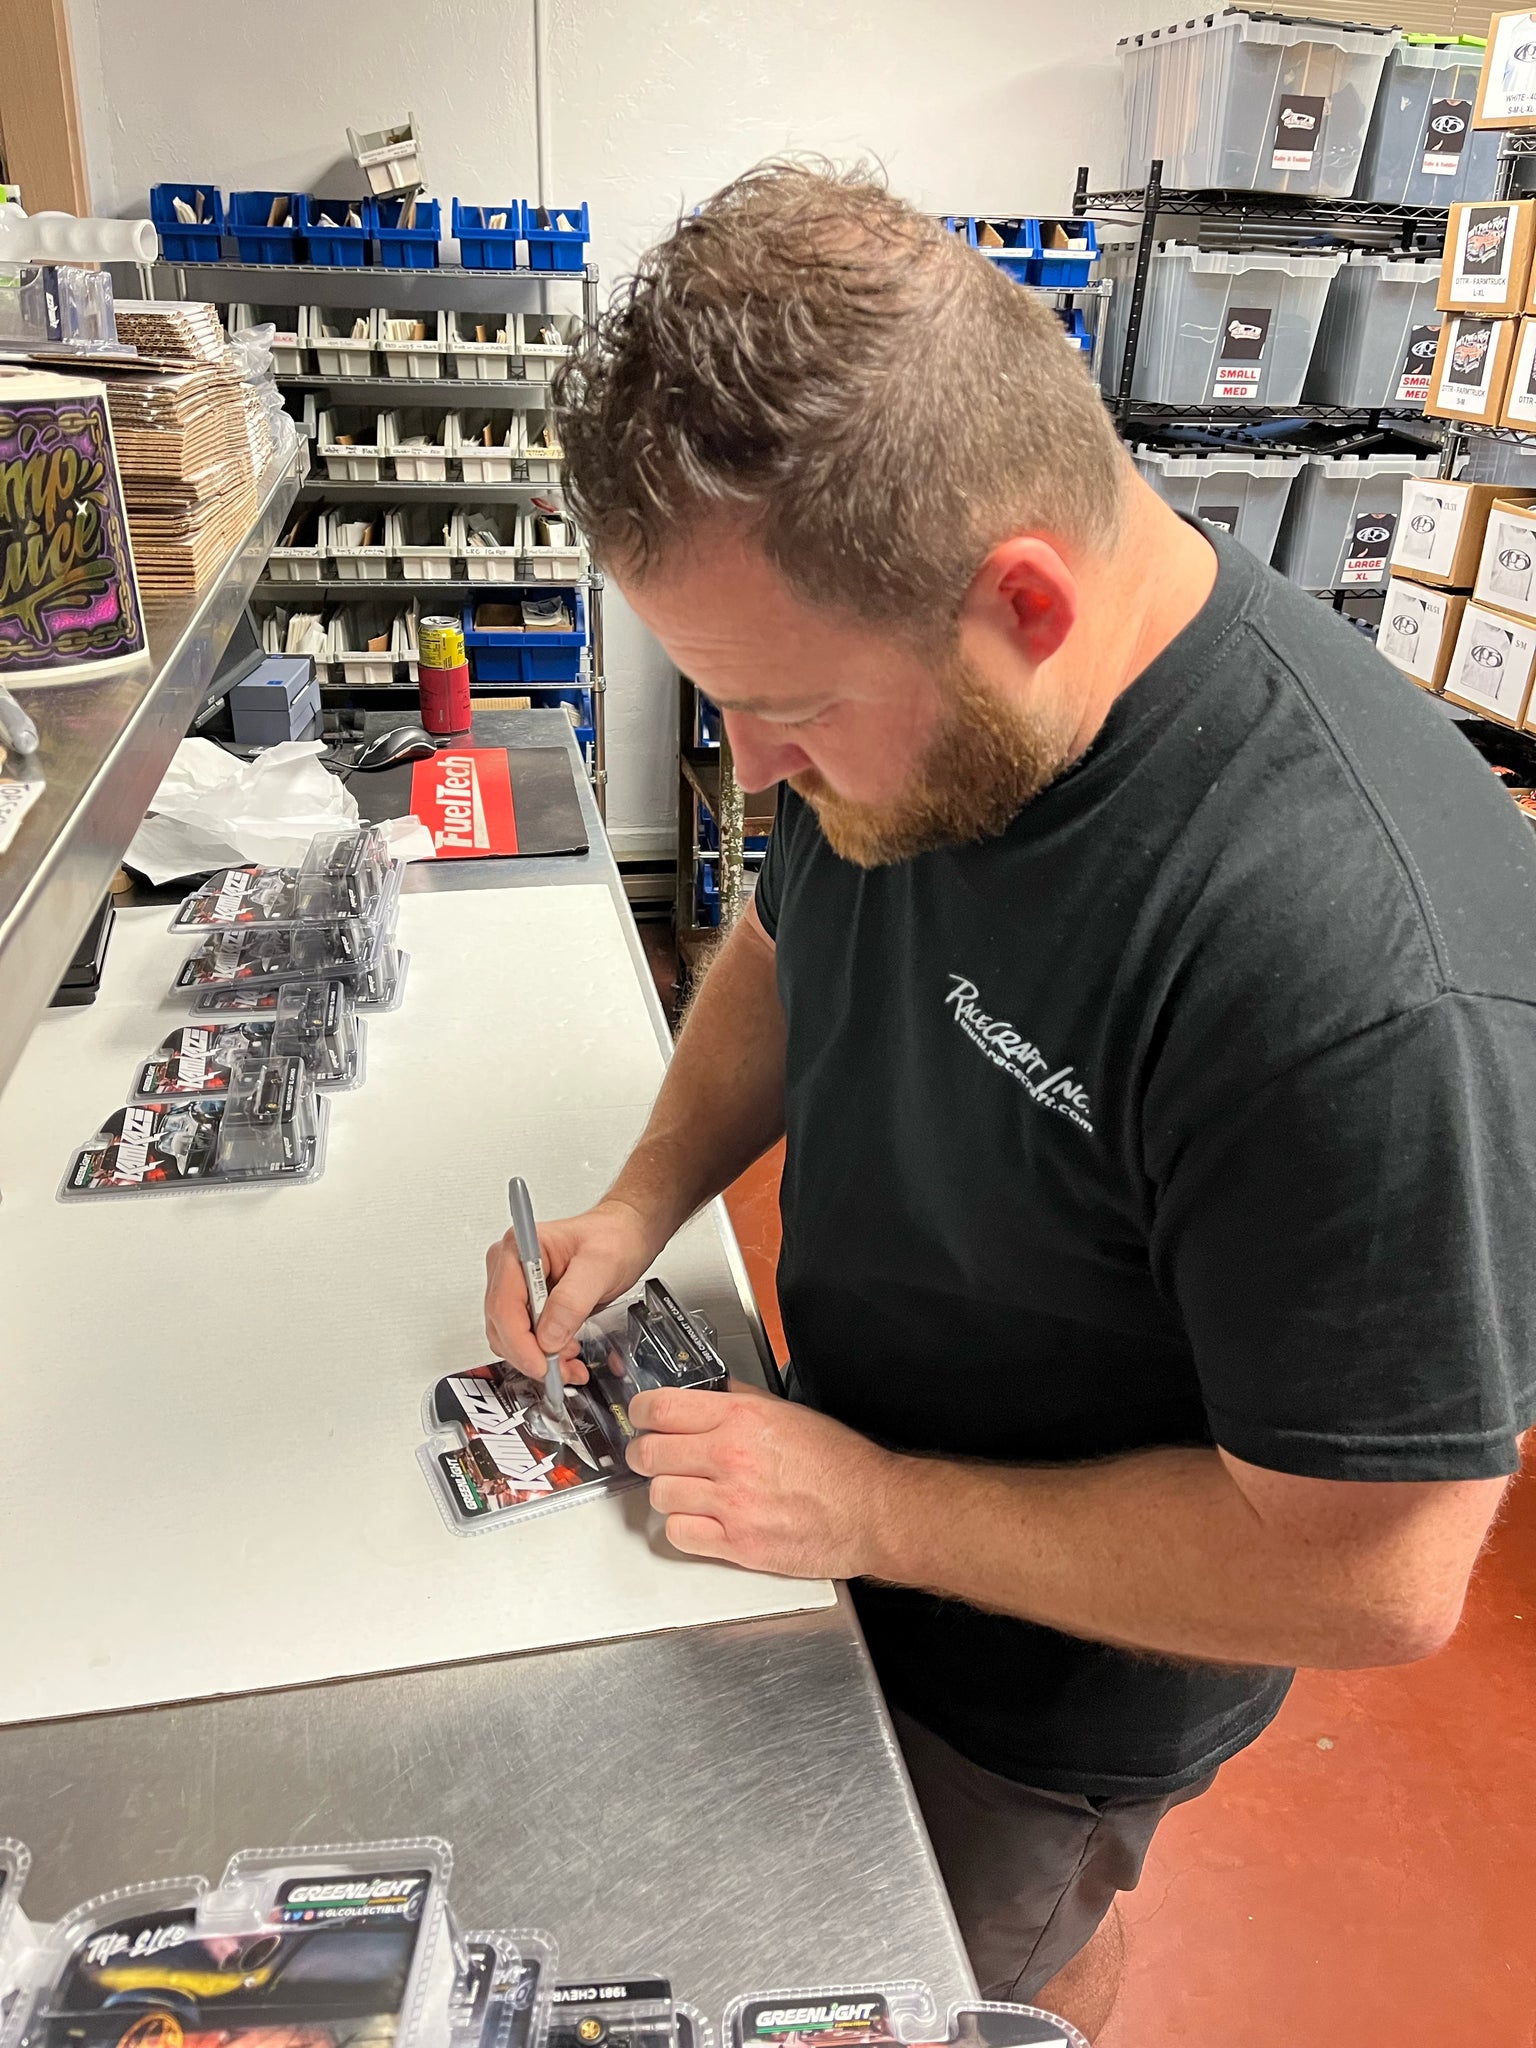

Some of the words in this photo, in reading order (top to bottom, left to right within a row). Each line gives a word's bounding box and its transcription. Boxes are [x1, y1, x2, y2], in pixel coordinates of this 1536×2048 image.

[1506, 94, 1525, 102] WHITE
[1473, 277, 1507, 285] FARMTRUCK
[1219, 369, 1257, 379] SMALL
[1223, 387, 1247, 396] MED
[1405, 390, 1428, 399] MED
[1348, 560, 1382, 569] LARGE
[1355, 573, 1368, 581] XL
[434, 755, 474, 849] FuelTech
[445, 1458, 478, 1511] GREENLIGHT
[287, 1878, 420, 1902] GREENLIGHT
[601, 1986, 627, 1998] 1981
[755, 2002, 877, 2027] GREENLIGHT
